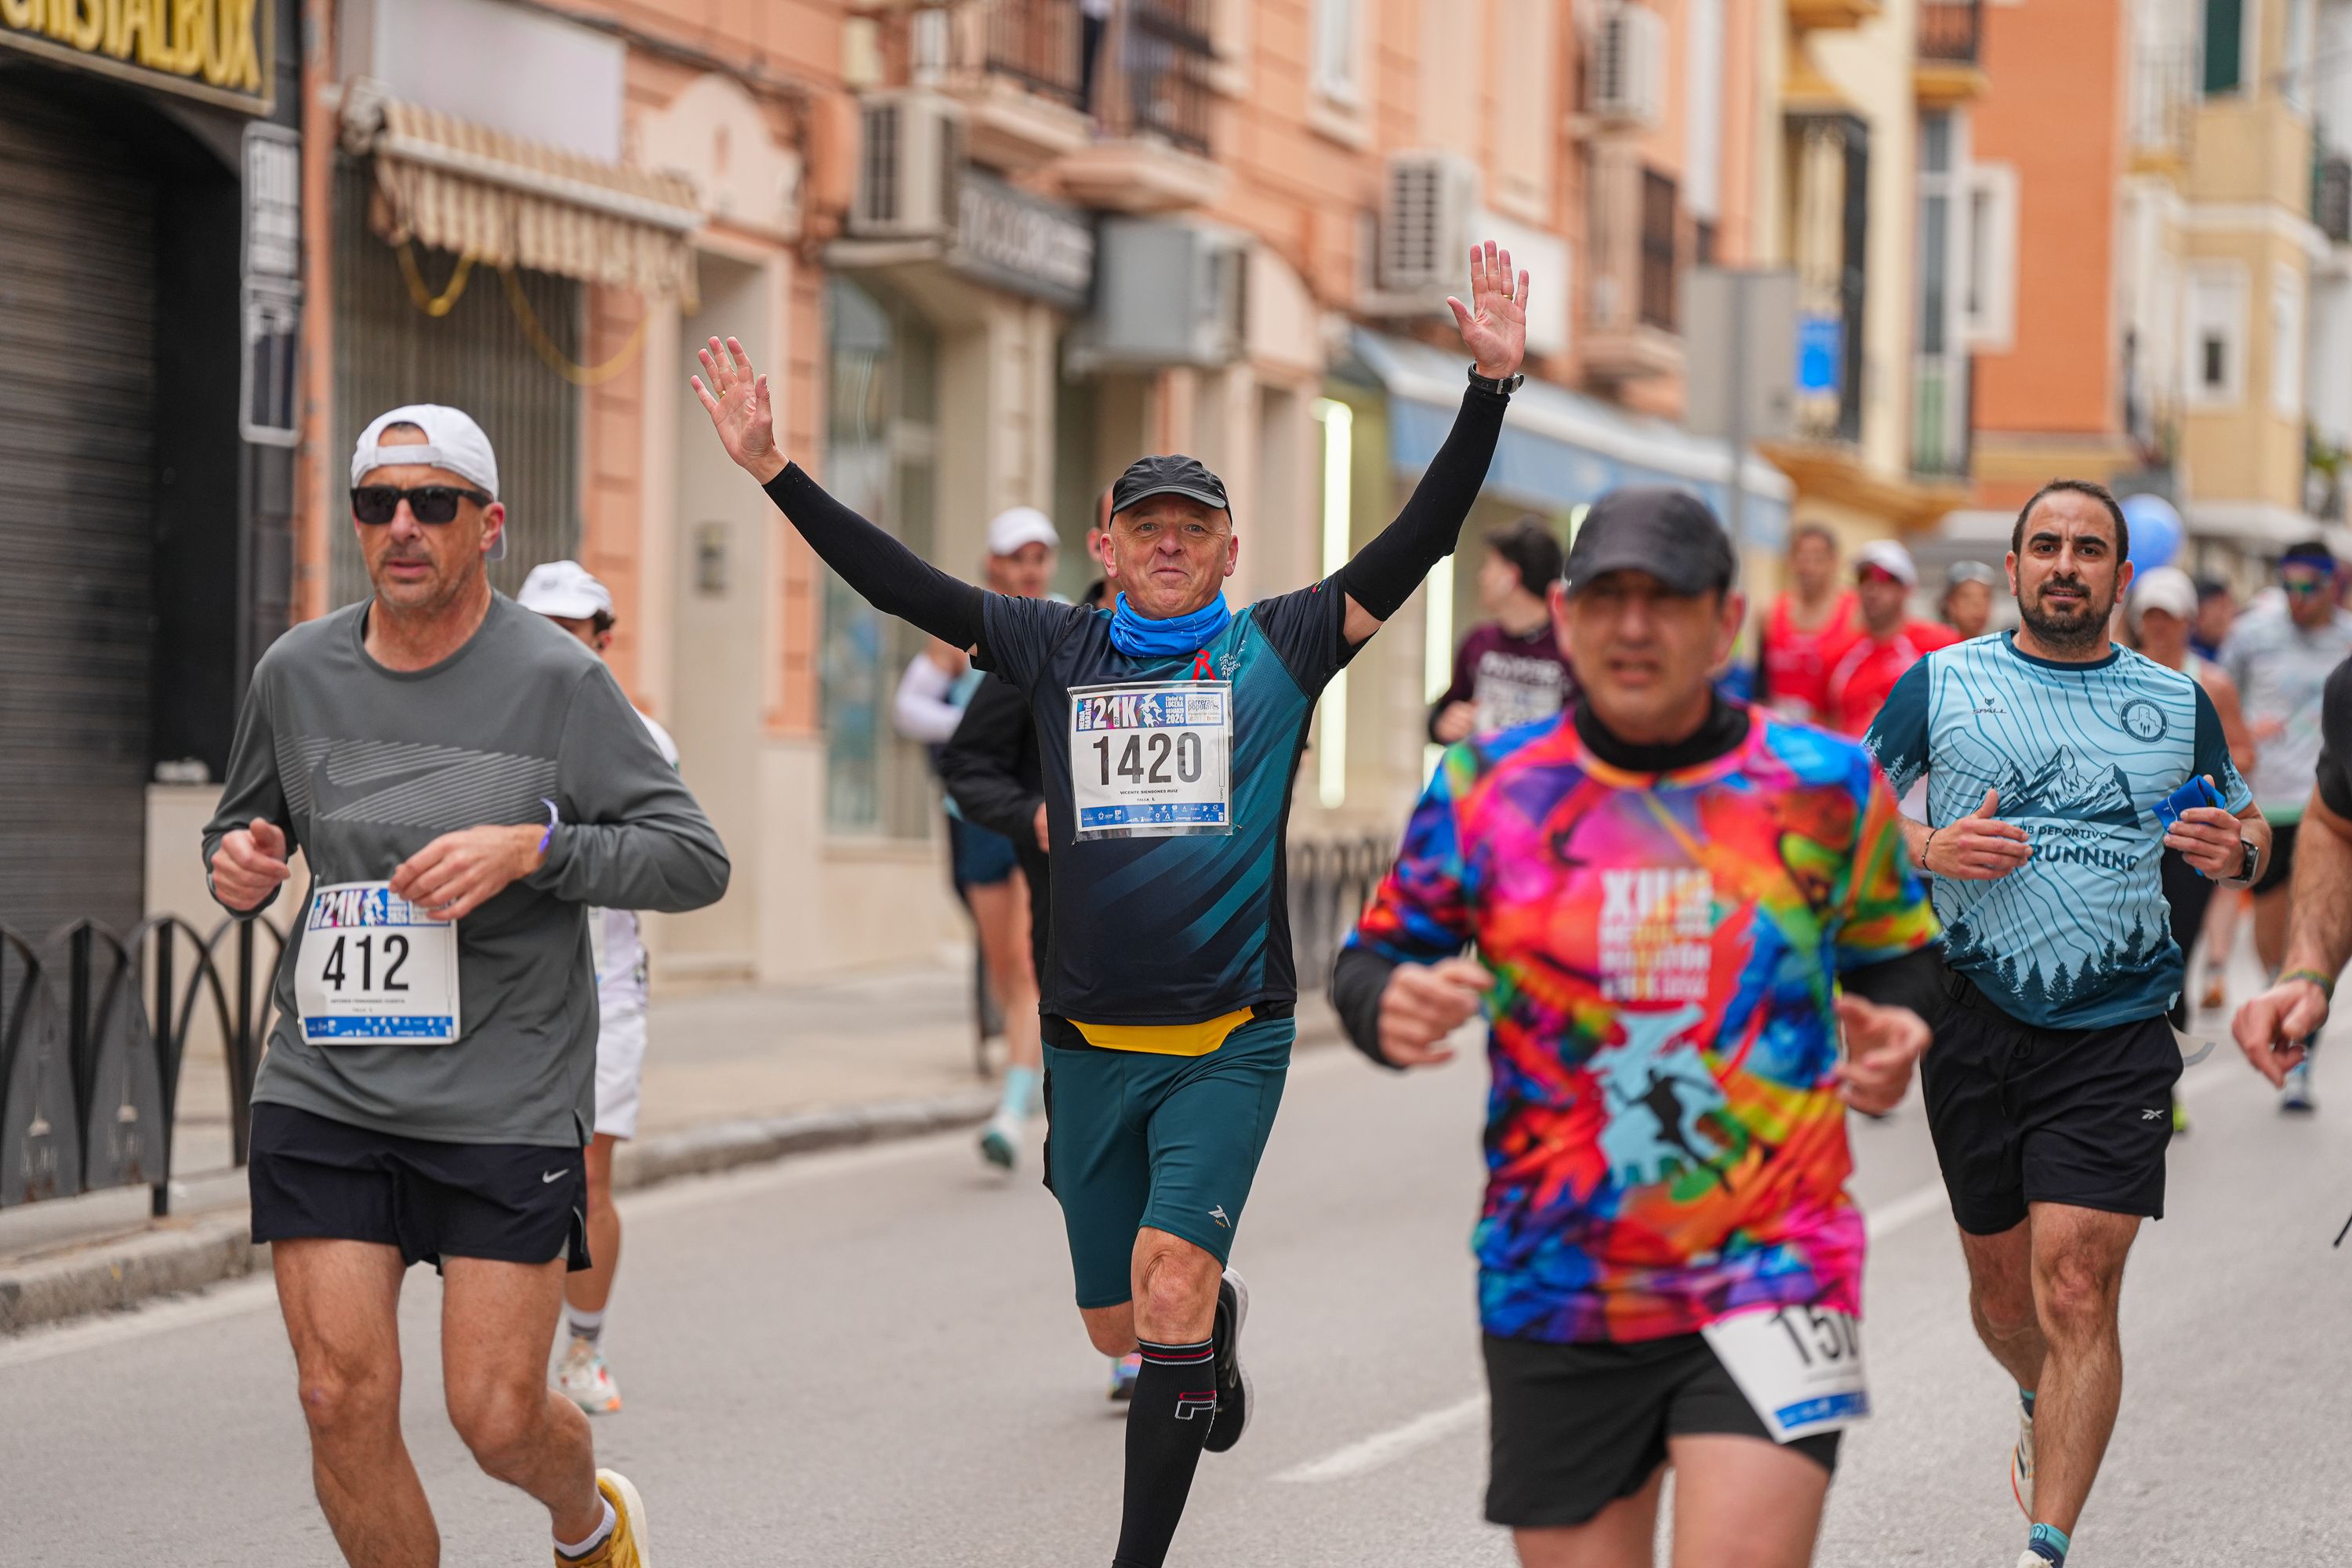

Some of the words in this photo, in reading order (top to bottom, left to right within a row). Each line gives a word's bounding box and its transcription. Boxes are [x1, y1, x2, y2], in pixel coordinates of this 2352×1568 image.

[0, 0, 262, 93] STALBOX
[1093, 696, 1138, 728] 21K
[1166, 713, 1185, 724] 2026
[1093, 731, 1202, 786] 1420
[2039, 826, 2108, 840] DEPORTIVO
[322, 890, 363, 927] 21K
[321, 934, 409, 991] 412
